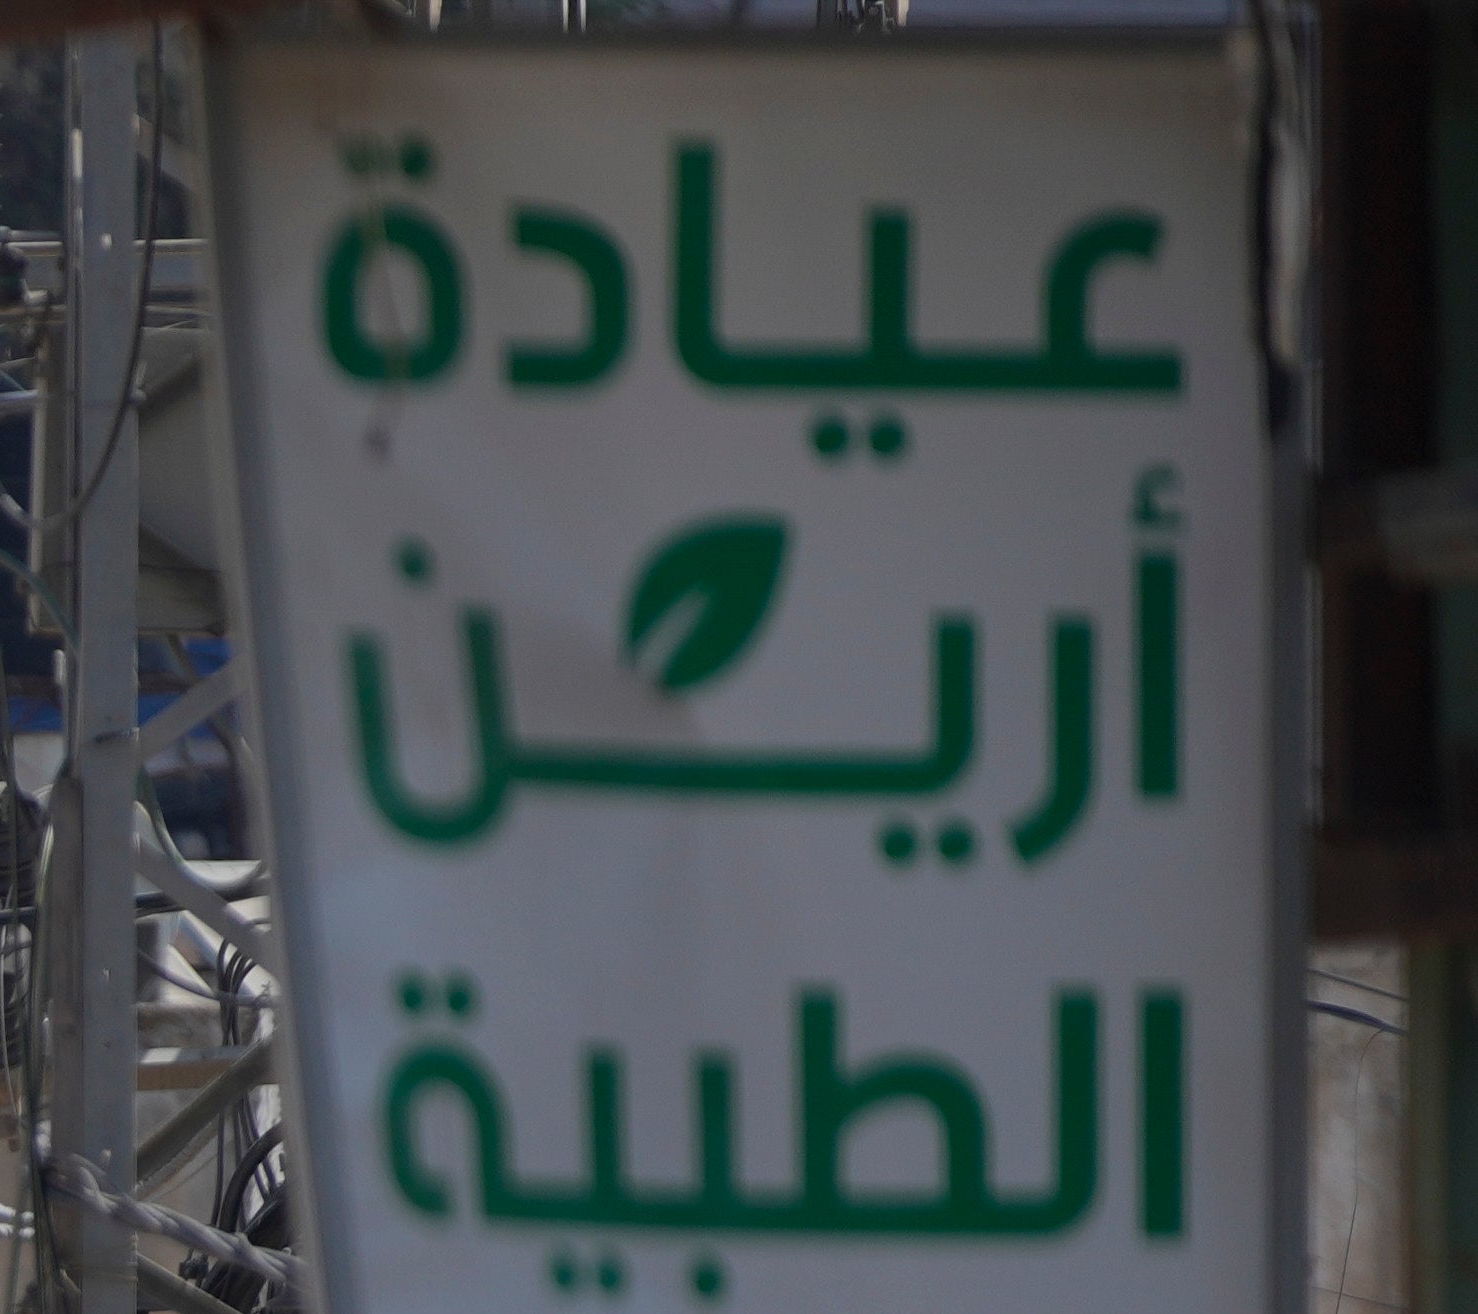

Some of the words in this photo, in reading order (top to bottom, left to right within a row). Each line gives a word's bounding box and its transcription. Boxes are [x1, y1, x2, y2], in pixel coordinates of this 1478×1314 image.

[321, 131, 1185, 460] عيادة
[344, 463, 1185, 864] أرين
[380, 970, 1186, 1302] الطبية
